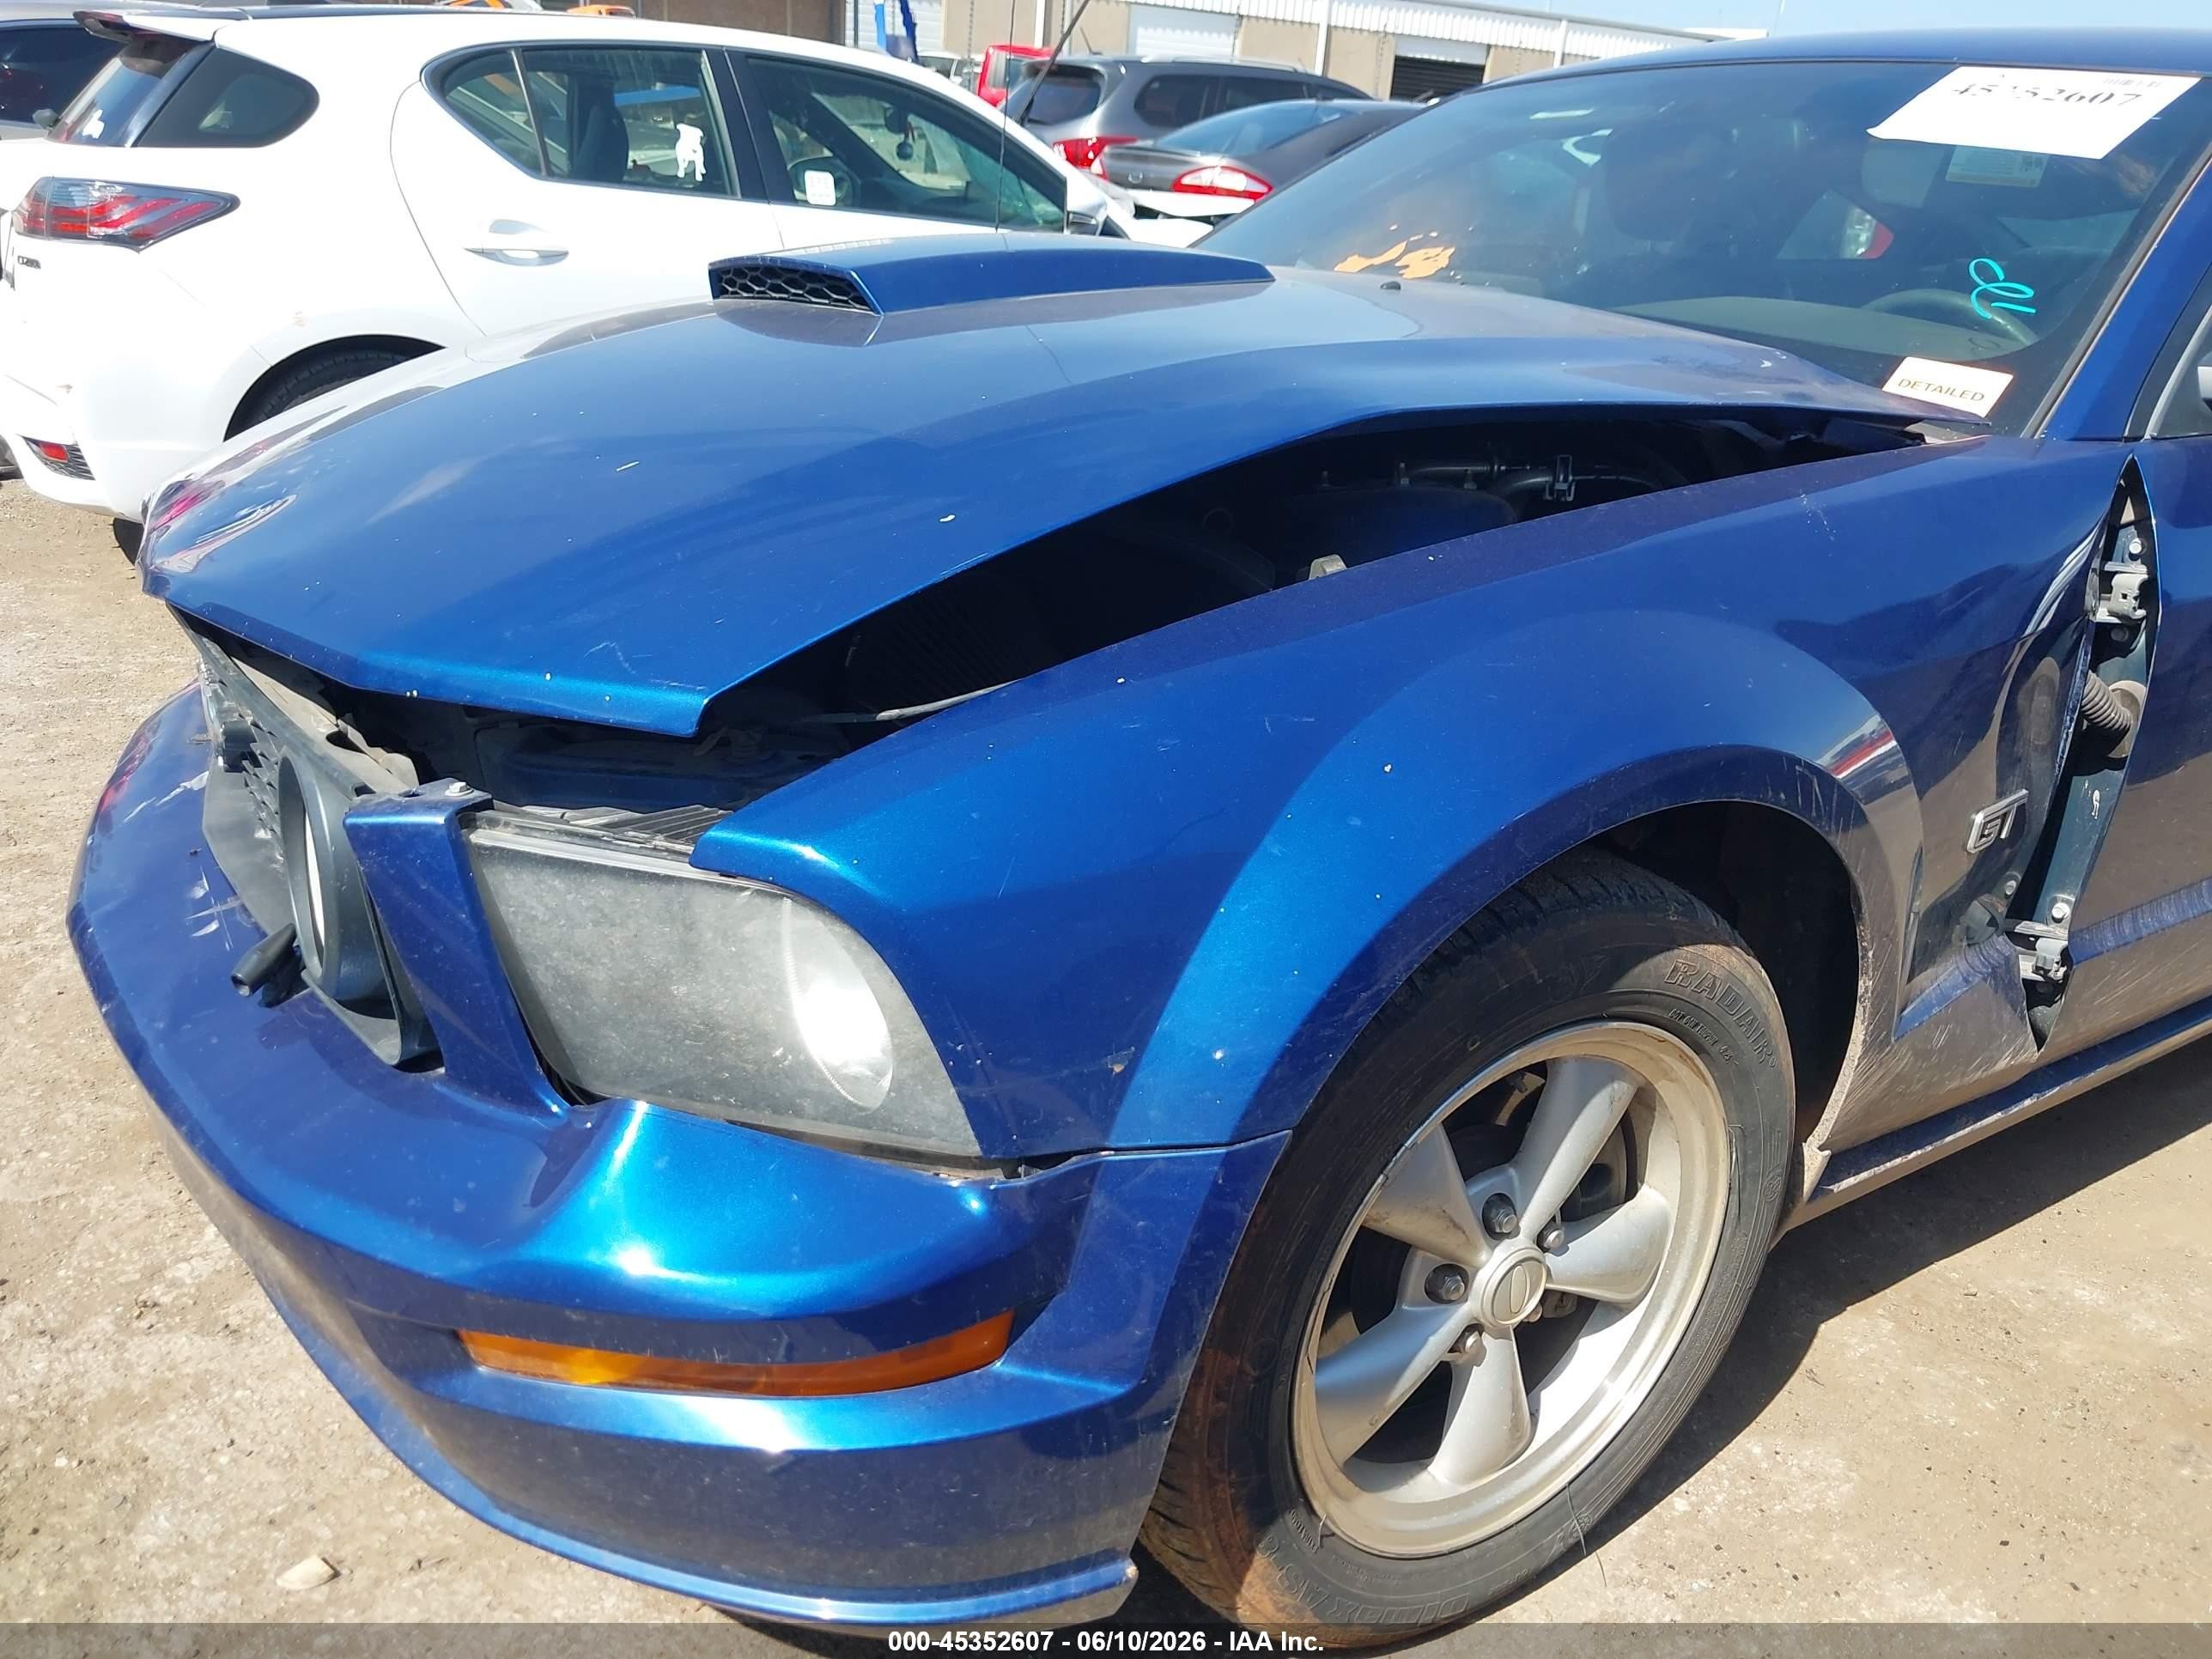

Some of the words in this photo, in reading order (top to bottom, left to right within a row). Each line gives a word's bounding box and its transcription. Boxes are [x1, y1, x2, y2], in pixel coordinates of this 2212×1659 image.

[1898, 379, 1984, 401] DETAILED
[1966, 788, 2029, 854] GT
[1664, 959, 1772, 1064] RADAR
